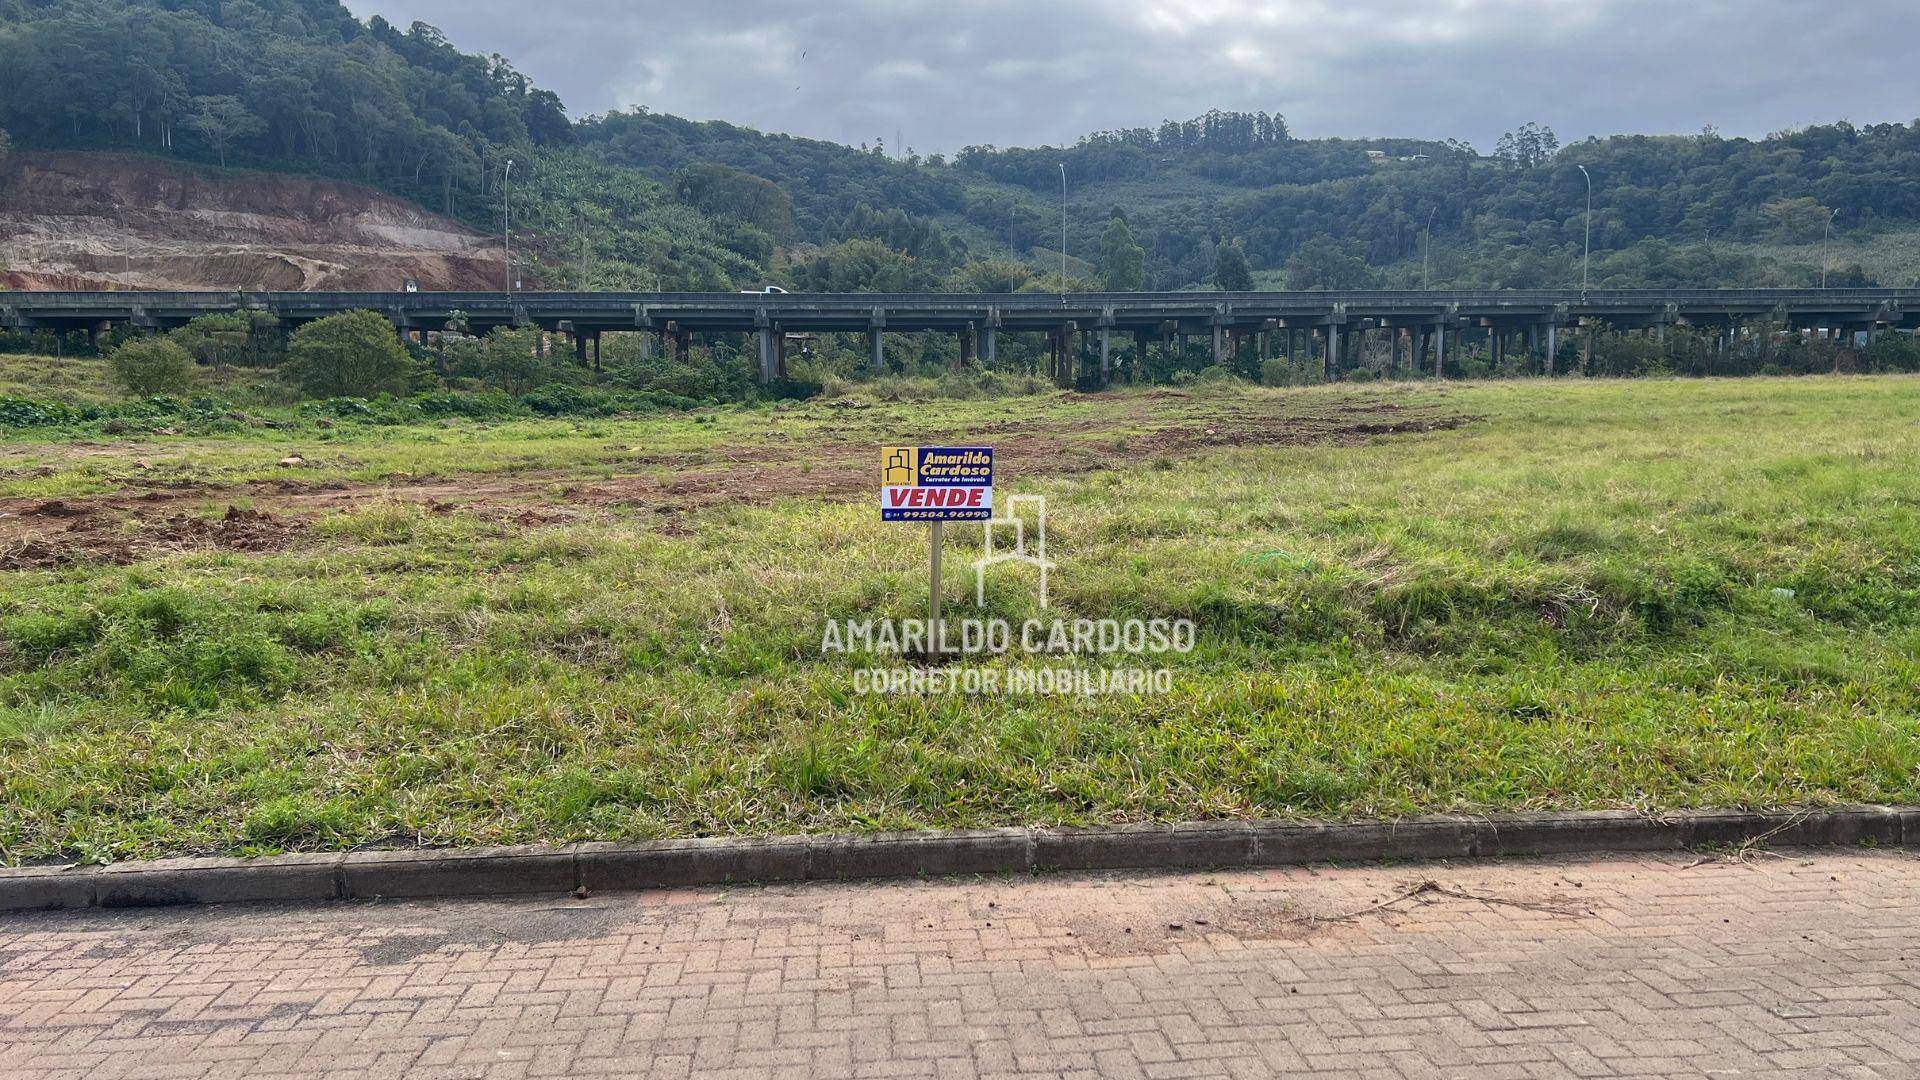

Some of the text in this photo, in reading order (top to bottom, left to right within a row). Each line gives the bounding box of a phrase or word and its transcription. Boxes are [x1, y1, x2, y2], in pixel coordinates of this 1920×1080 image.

[924, 451, 990, 465] Amarildo
[920, 465, 990, 476] Cardoso
[890, 488, 985, 507] VENDE
